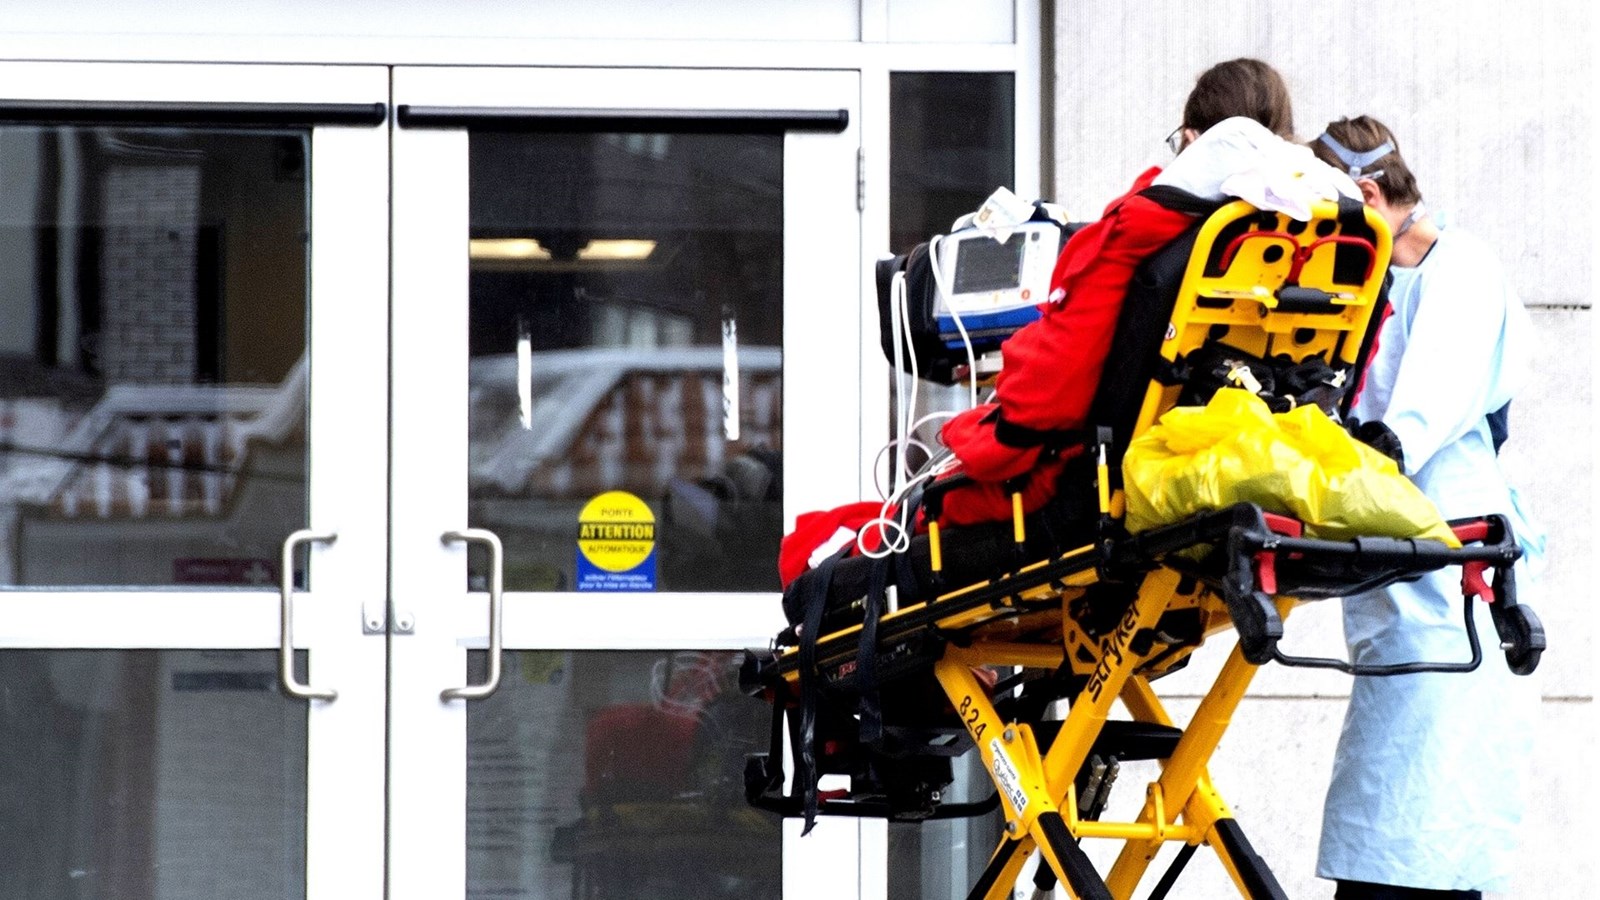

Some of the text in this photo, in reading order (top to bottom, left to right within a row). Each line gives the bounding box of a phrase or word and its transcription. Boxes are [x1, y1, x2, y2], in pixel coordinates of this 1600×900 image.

[601, 508, 633, 517] PORTE
[580, 523, 654, 539] ATTENTION
[588, 544, 646, 554] AUTOMATIQUE
[1088, 593, 1140, 703] stryker
[960, 695, 987, 741] 824
